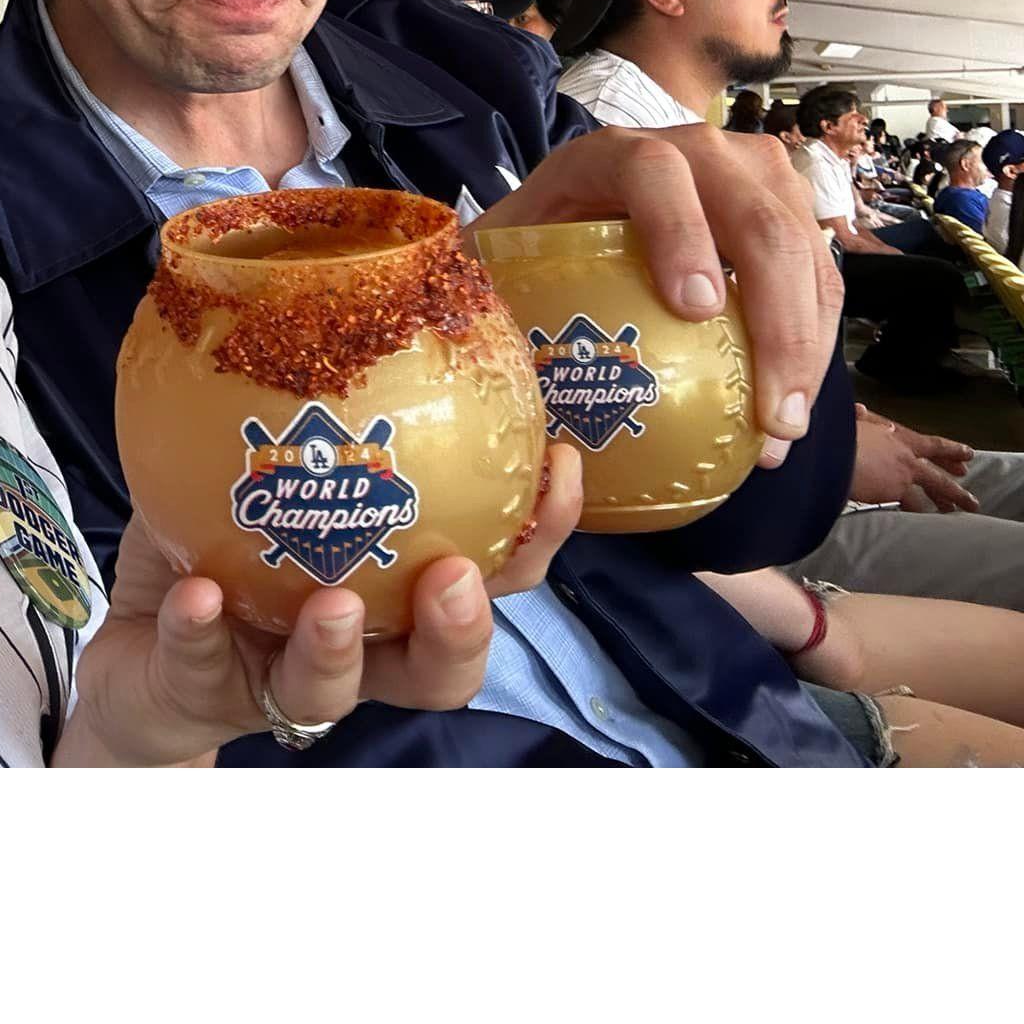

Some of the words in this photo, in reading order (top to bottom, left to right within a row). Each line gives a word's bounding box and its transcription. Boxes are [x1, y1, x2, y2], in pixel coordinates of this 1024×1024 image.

[553, 365, 622, 382] WORLD
[269, 448, 295, 463] 20
[275, 477, 371, 501] WORLD
[238, 489, 416, 539] Champions
[13, 521, 81, 587] GAME
